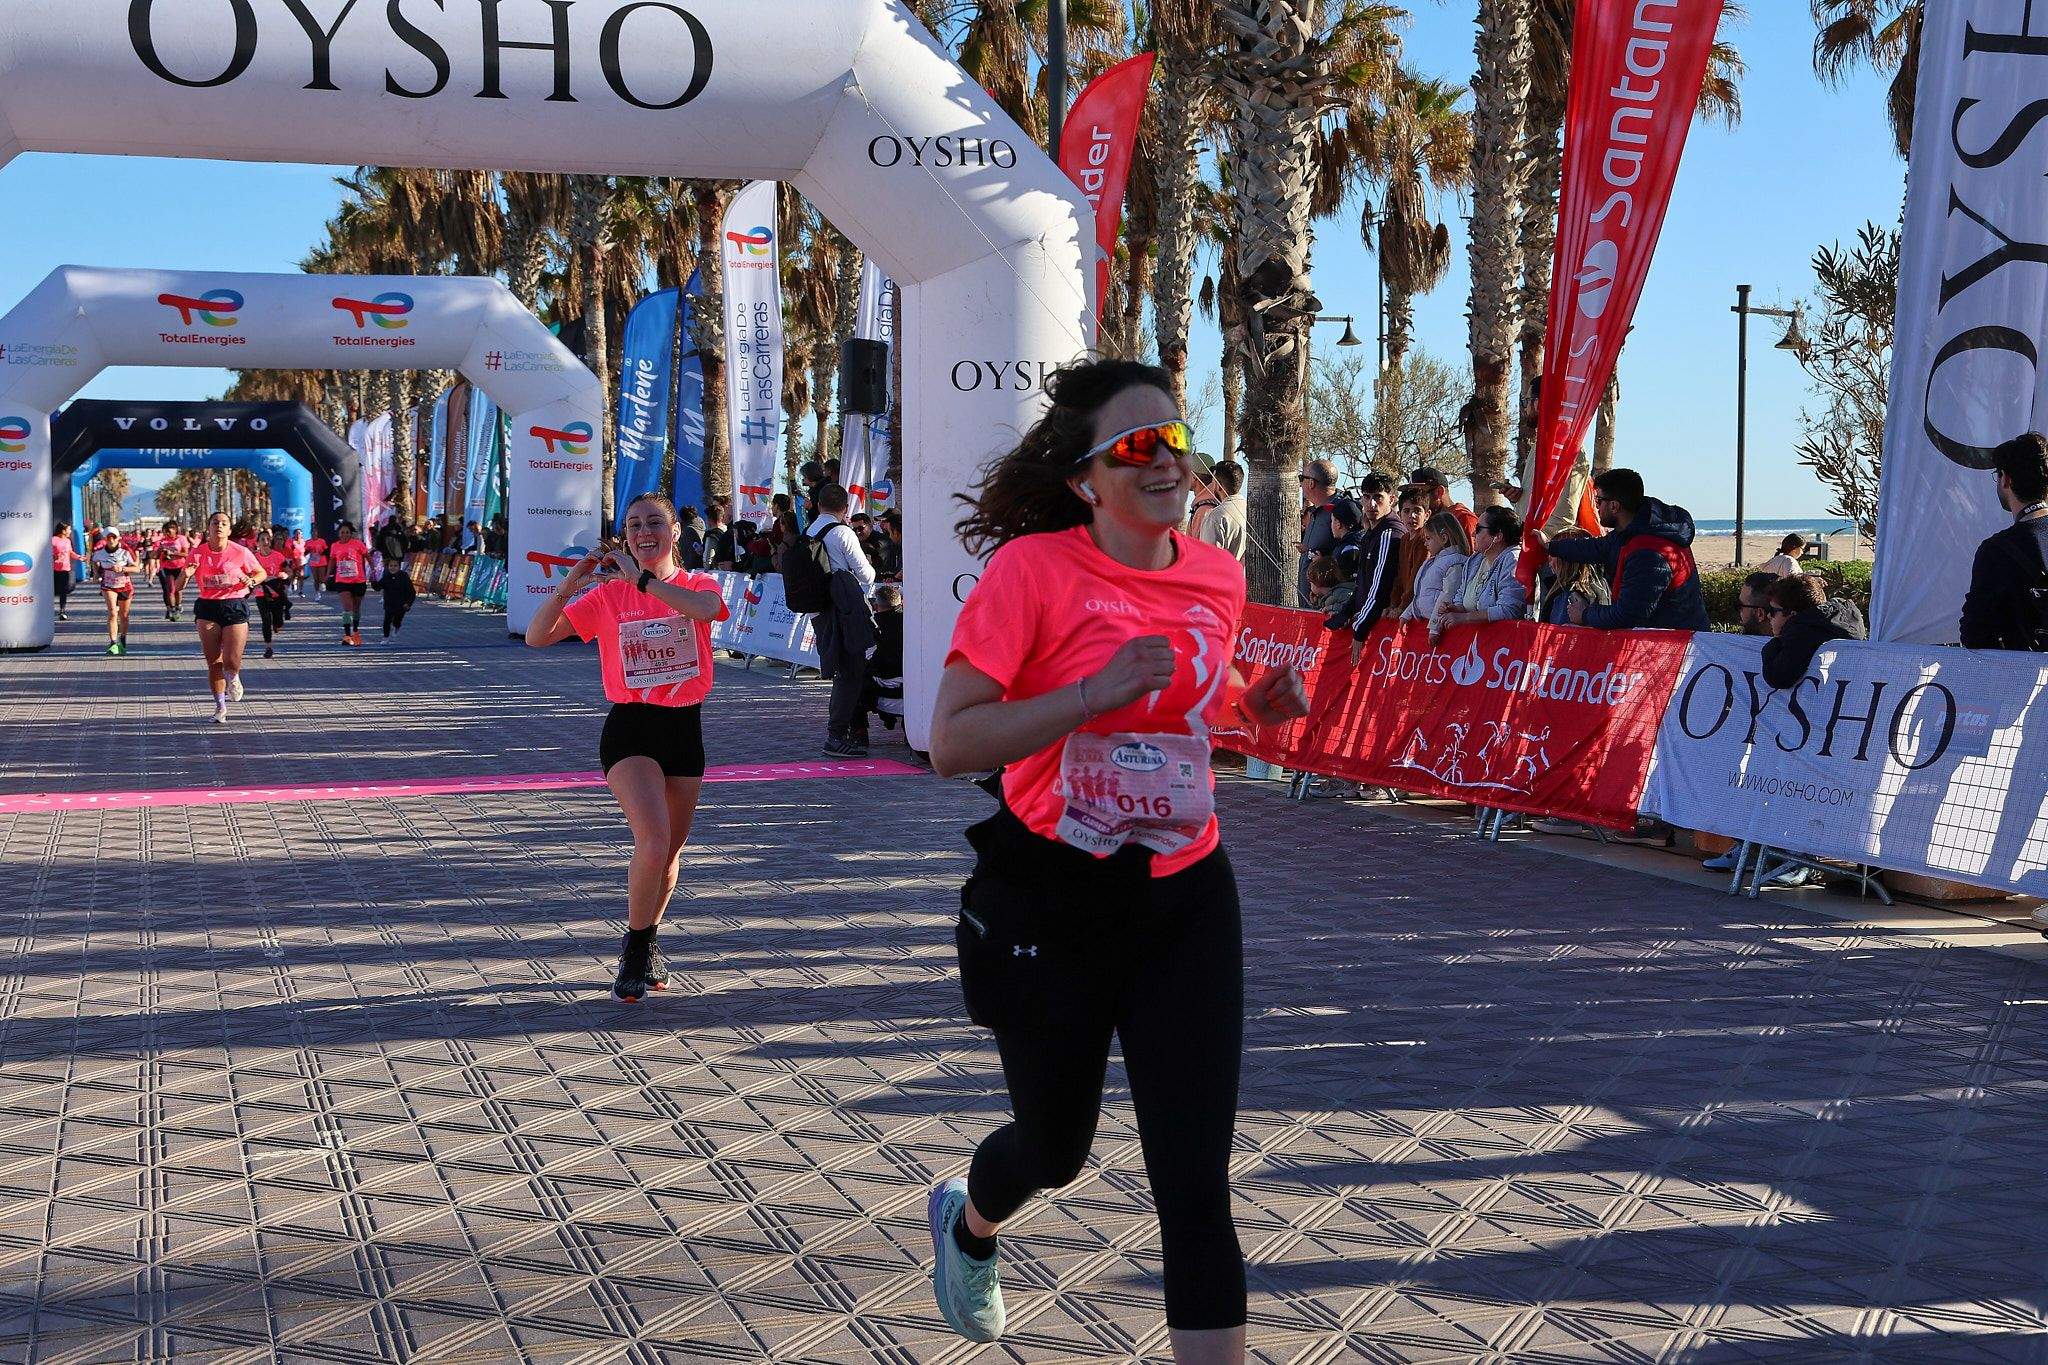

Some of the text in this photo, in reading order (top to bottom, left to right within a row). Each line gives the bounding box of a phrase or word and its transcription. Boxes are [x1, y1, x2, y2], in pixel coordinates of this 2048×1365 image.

[128, 0, 714, 110] OYSHO
[868, 135, 1017, 169] OYSHO
[728, 260, 774, 271] TotalEnergies
[159, 332, 246, 346] TotalEnergies
[332, 336, 416, 348] TotalEnergies
[753, 301, 774, 411] LasCarreras
[951, 360, 1060, 392] OYSH
[113, 417, 268, 431] VOLVO
[621, 358, 663, 462] Marlene
[528, 460, 593, 472] TotalEnergies
[528, 507, 592, 517] totalenergies.es
[647, 647, 676, 660] 016
[1235, 627, 1323, 671] Santander
[1372, 637, 1645, 706] Sports Santander
[1679, 663, 1956, 770] OYSHO
[1728, 770, 1854, 807] WWW.OYSHO.COM
[1116, 794, 1172, 818] 016
